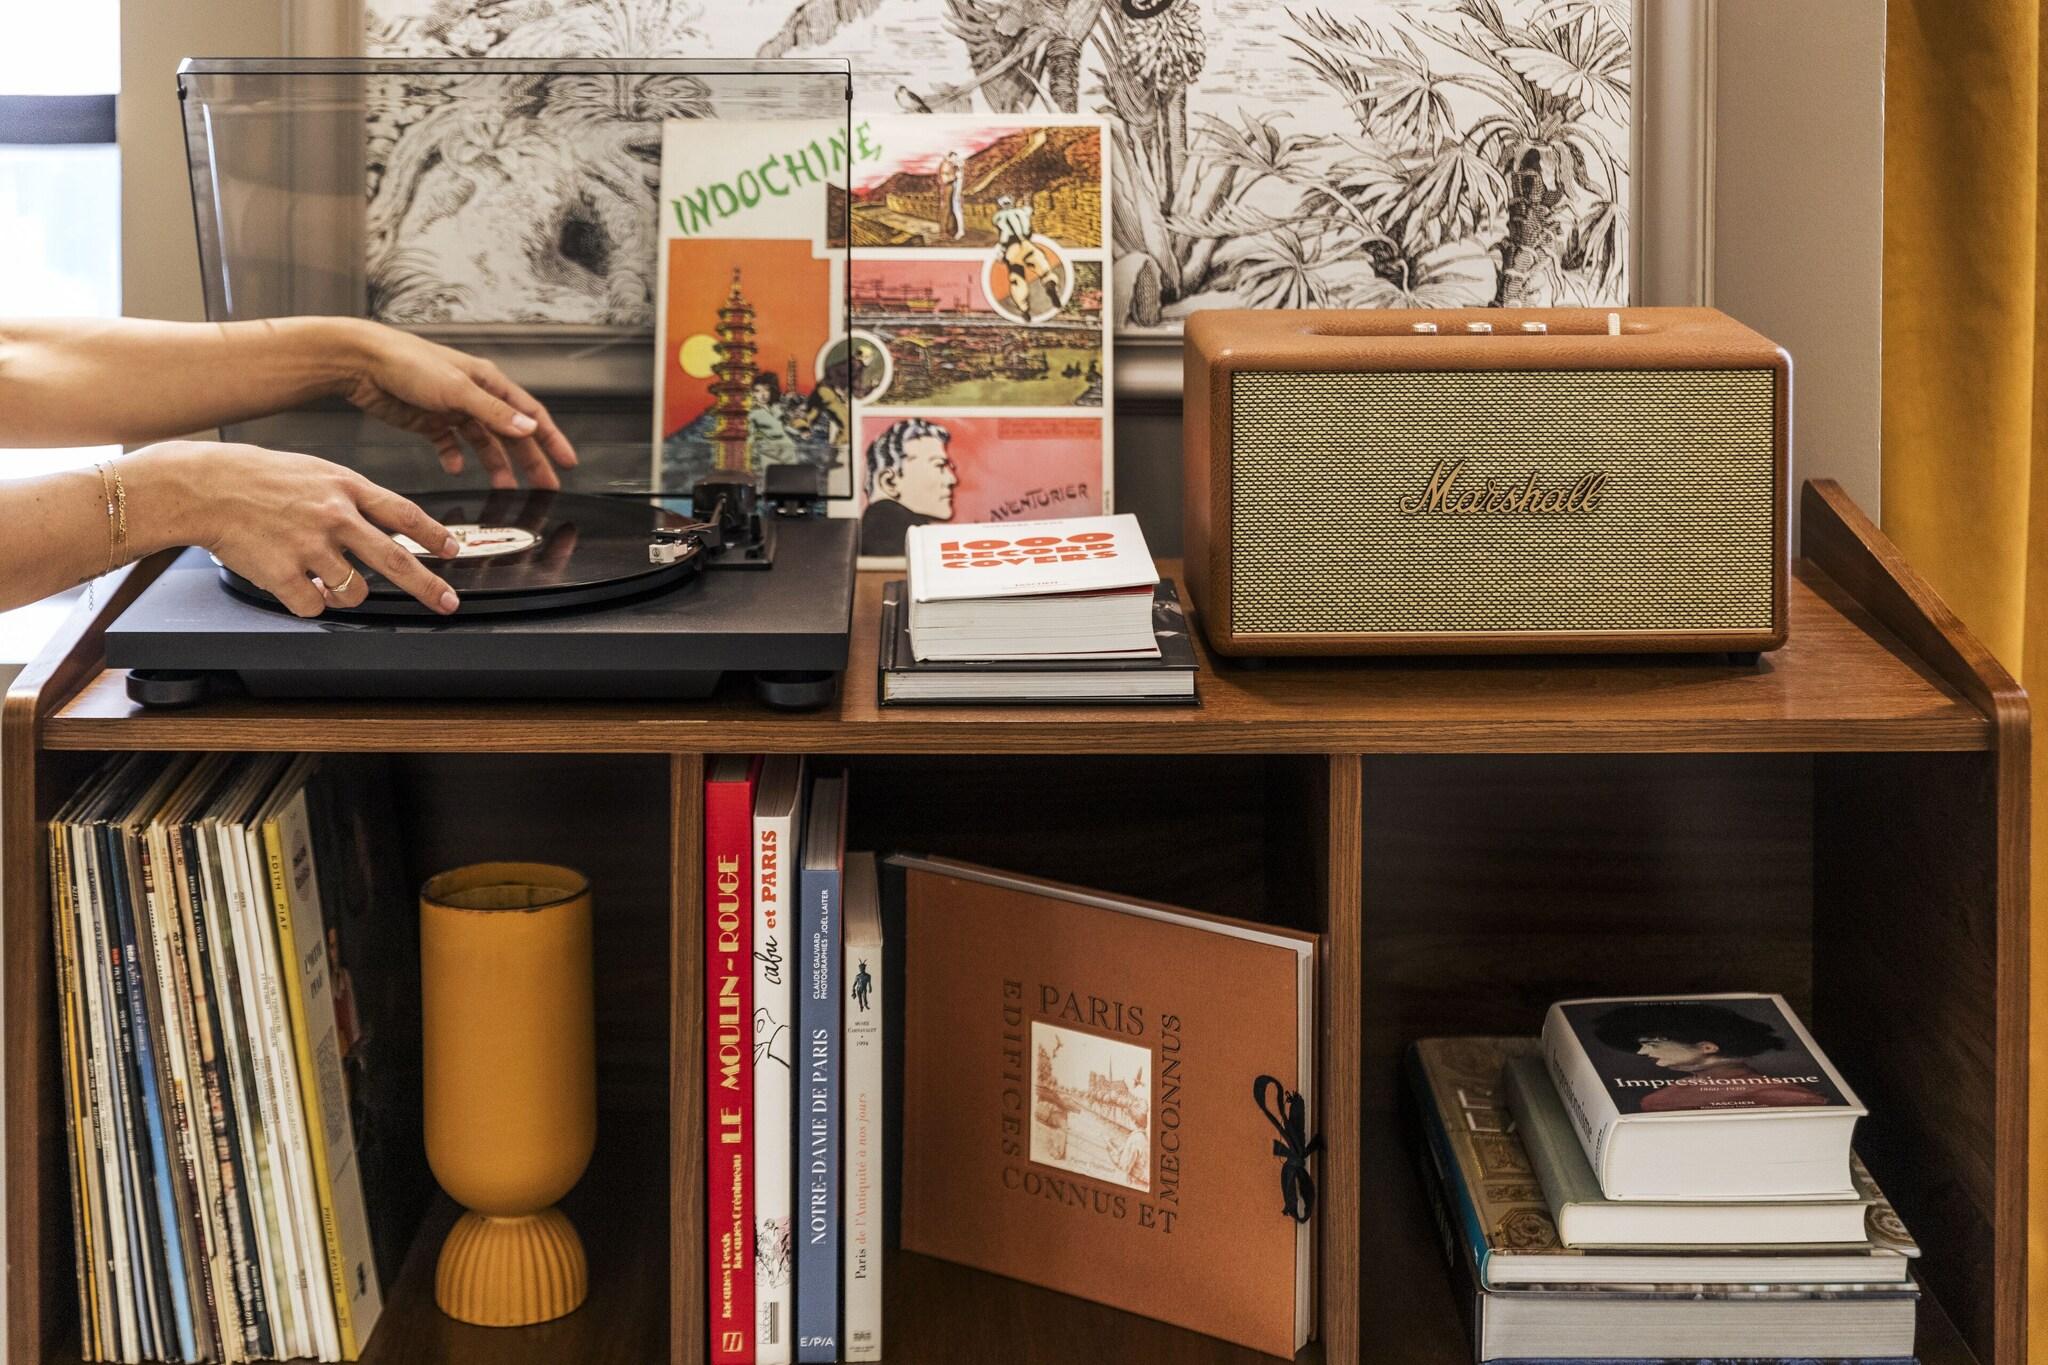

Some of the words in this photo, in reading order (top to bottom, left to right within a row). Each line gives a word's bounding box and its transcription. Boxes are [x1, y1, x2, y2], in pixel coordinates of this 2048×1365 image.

[671, 122, 883, 235] INDOCHINE
[1400, 460, 1609, 514] Marshall
[940, 533, 1114, 551] 1000
[941, 543, 1115, 560] RECORD
[943, 551, 1118, 568] COVERS
[761, 830, 777, 902] PARIS
[191, 896, 200, 913] LAMA
[270, 855, 283, 890] EDITH
[277, 904, 288, 930] PIAF
[718, 854, 740, 952] ROUGE
[821, 889, 829, 914] LAITER
[767, 911, 777, 929] et
[819, 915, 829, 934] JOËL
[126, 944, 136, 962] RCA
[754, 936, 781, 985] cabu
[820, 939, 828, 999] PHOTOGRAPHIES
[1039, 984, 1144, 1036] PARIS
[812, 1029, 828, 1083] PARIS
[1002, 979, 1022, 1158] EDIFICES
[812, 1087, 828, 1113] DE
[1614, 1075, 1820, 1089] Impressionnisme
[721, 1106, 742, 1144] LE
[857, 1093, 872, 1124] jours
[1160, 1014, 1181, 1206] MECONNUS
[858, 1125, 866, 1146] nos
[811, 1117, 827, 1245] NOTRE-DAME
[855, 1161, 872, 1227] l'Antiquité
[1002, 1168, 1126, 1219] CONNUS
[1138, 1203, 1177, 1234] ET
[732, 1220, 743, 1269] Jacques
[855, 1231, 866, 1245] de
[855, 1248, 866, 1279] Paris
[722, 1270, 732, 1319] Jacques
[800, 1337, 834, 1348] E/P/A
